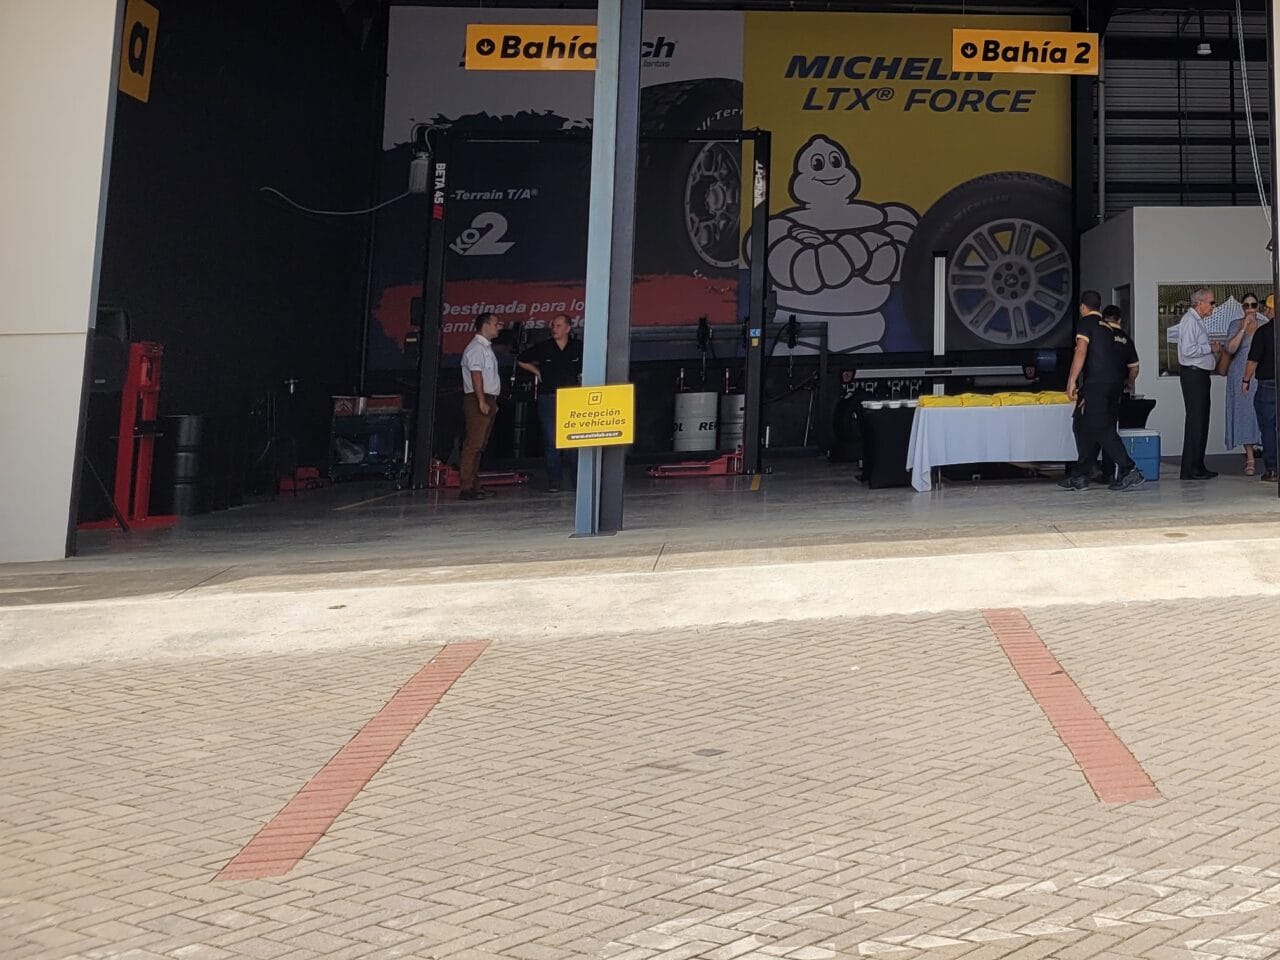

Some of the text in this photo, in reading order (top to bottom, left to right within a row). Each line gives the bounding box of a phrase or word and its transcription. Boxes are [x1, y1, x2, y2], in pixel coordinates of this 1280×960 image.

[501, 35, 597, 59] Bahía
[982, 39, 1092, 64] Bahía 2
[784, 55, 993, 82] MICHEL
[903, 88, 1036, 113] FORCE
[434, 162, 446, 204] BETA 45
[450, 189, 503, 200] -Terrain
[529, 301, 566, 316] para
[570, 299, 586, 311] lo
[563, 417, 626, 429] de vehículos
[569, 408, 621, 419] Recepción
